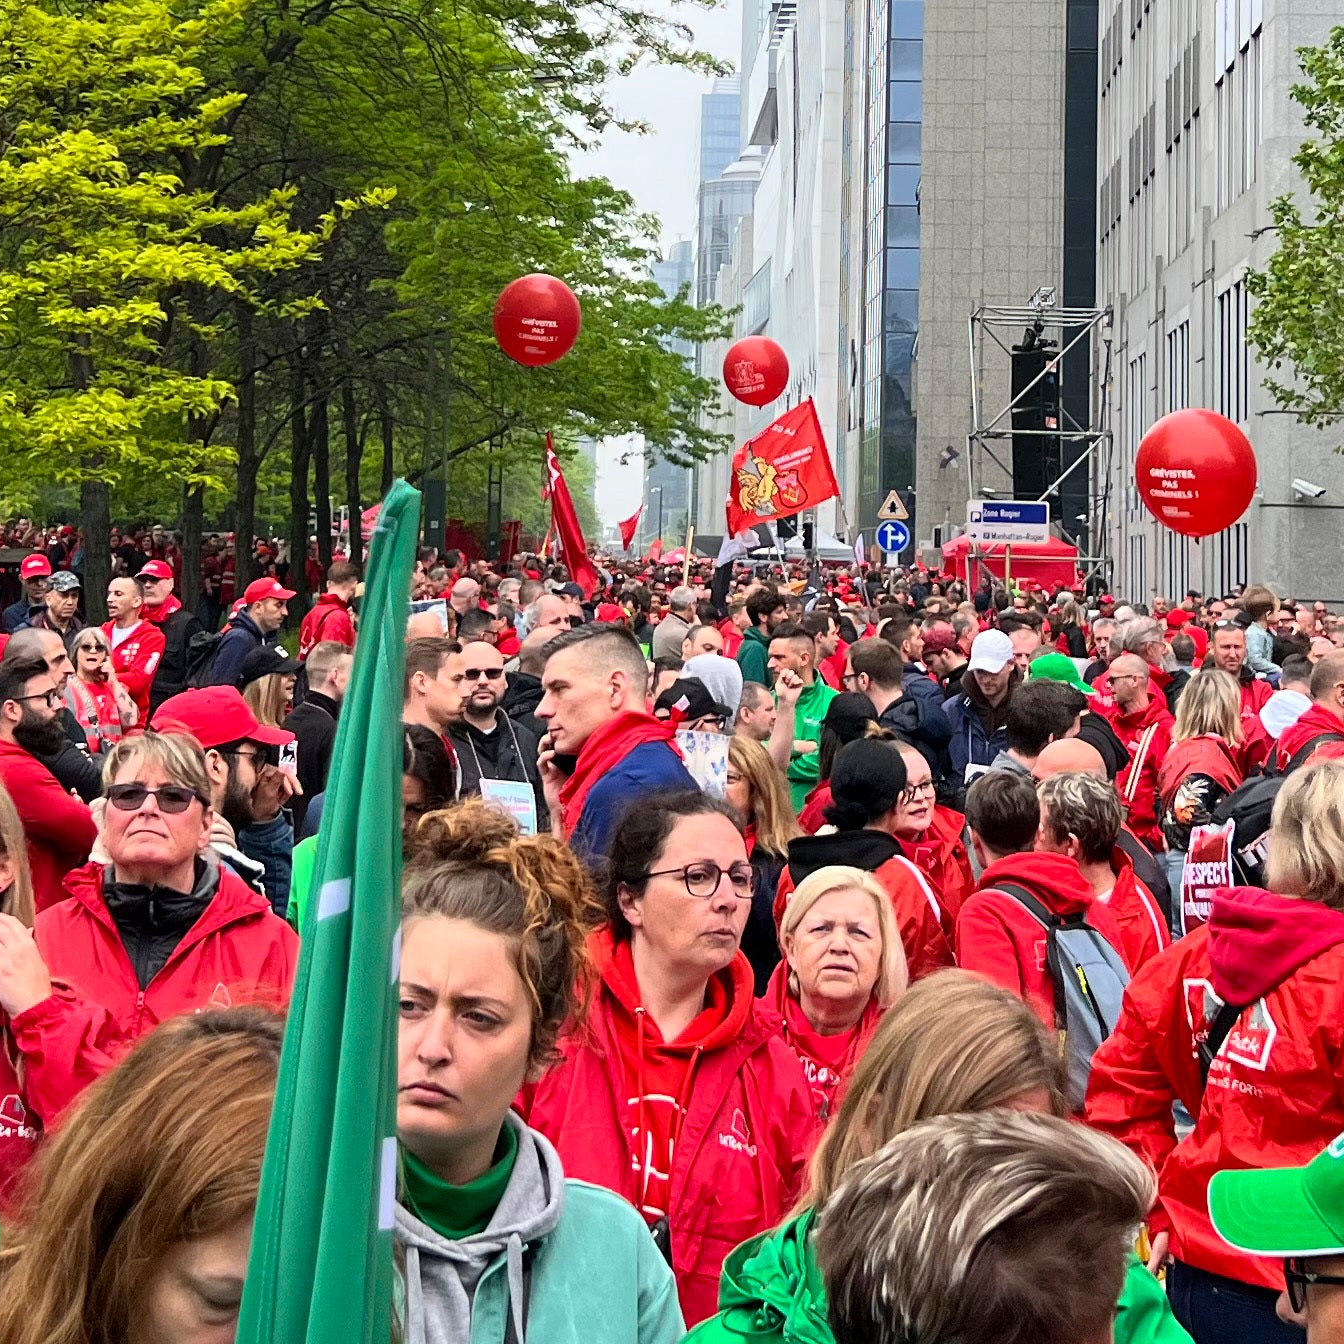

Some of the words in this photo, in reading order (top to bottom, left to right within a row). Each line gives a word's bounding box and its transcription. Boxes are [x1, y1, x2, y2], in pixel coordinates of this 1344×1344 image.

[1161, 480, 1178, 489] PAS
[982, 508, 998, 517] Zone
[999, 508, 1021, 519] Rogier
[1184, 861, 1227, 886] RESPECT
